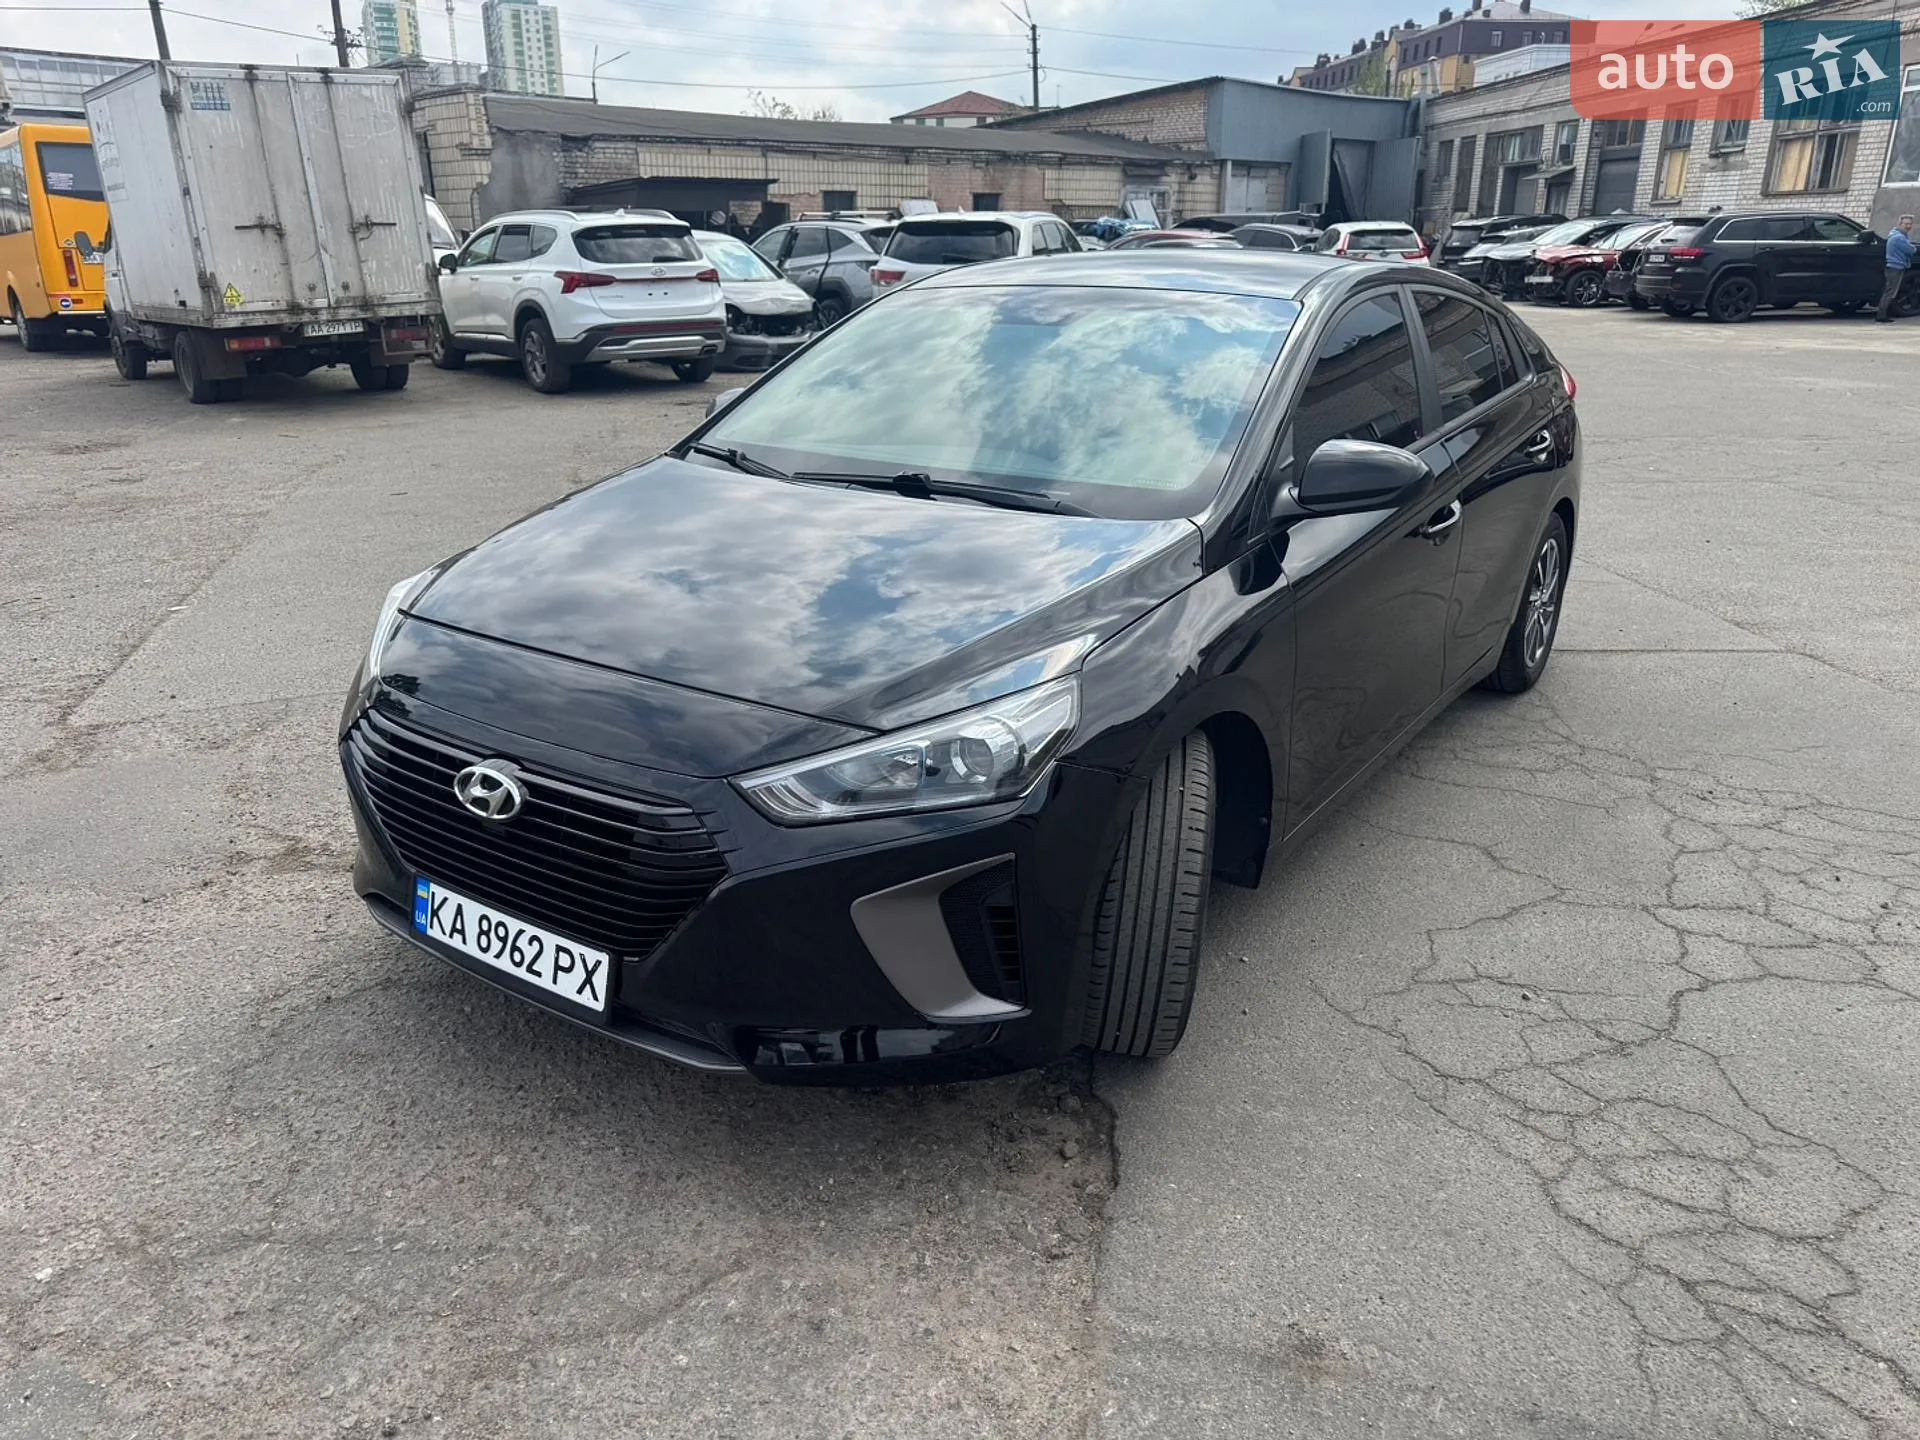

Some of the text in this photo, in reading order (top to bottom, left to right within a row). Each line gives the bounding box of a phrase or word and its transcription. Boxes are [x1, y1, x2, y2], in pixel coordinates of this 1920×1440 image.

[415, 910, 427, 926] UA
[430, 891, 603, 1003] KA 8962 PX
